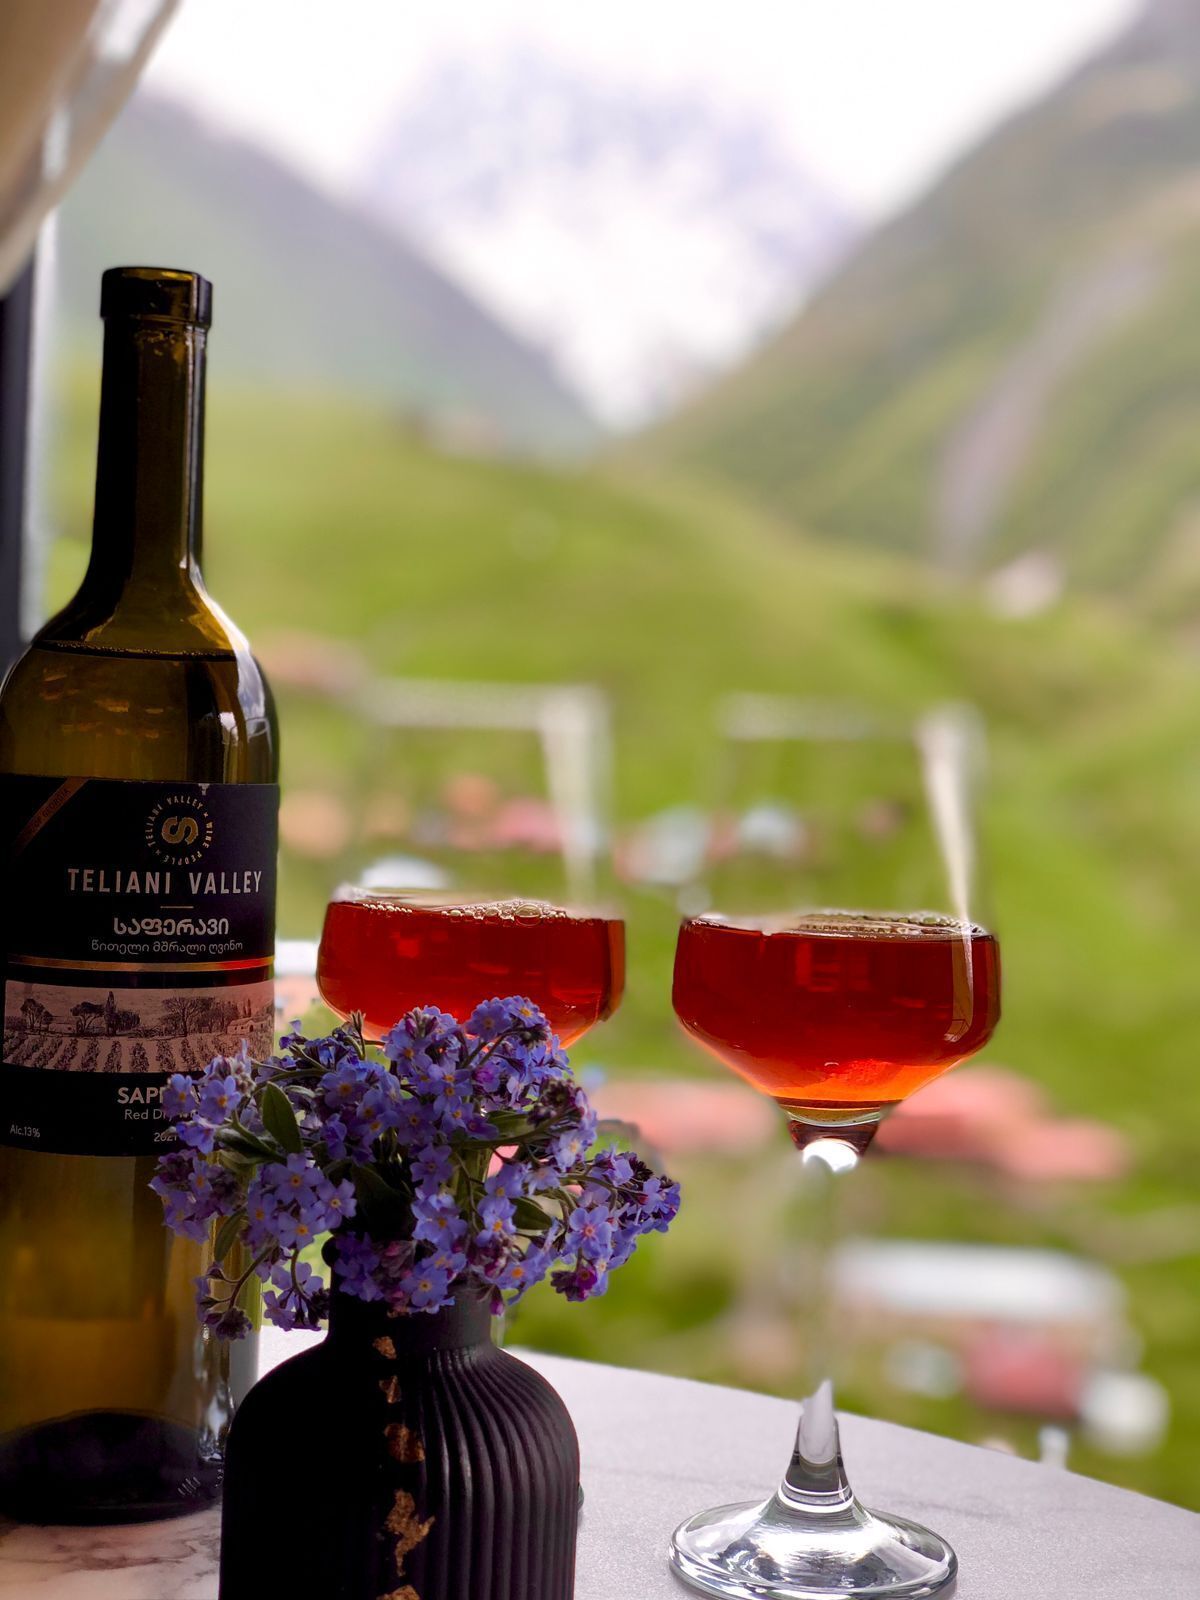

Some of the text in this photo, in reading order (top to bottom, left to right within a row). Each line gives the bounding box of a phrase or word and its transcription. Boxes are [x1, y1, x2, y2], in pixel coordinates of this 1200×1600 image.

[145, 804, 163, 848] TELIANI
[166, 795, 203, 810] VALLEY
[202, 821, 213, 849] WINE
[67, 868, 262, 895] TELIANI VALLEY
[113, 917, 229, 936] საფერავი
[91, 938, 243, 955] წითელი მშრალი ღვინო
[124, 1109, 149, 1120] Red
